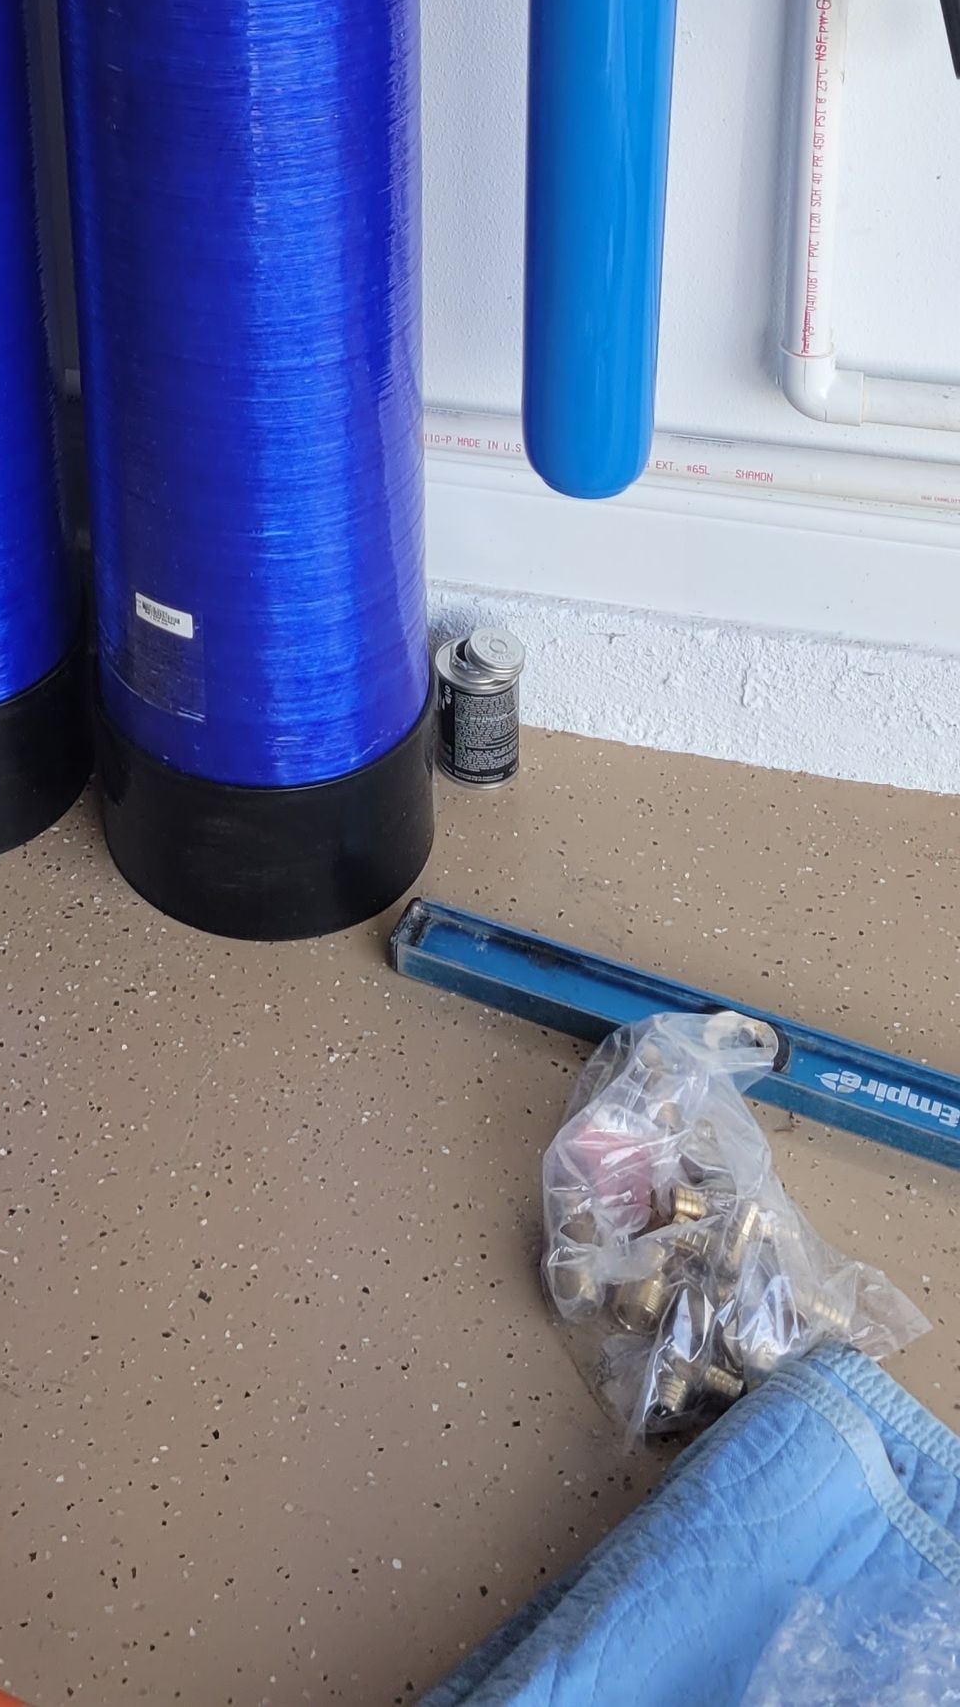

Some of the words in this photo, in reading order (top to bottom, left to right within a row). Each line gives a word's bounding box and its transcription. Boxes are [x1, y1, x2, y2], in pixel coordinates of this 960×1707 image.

[814, 110, 826, 127] PSI
[813, 133, 825, 150] 450
[812, 155, 824, 168] PR
[812, 173, 823, 185] 40
[810, 189, 822, 207] SCH
[809, 239, 820, 258] PVC
[457, 437, 481, 448] MADE
[487, 440, 498, 451] IN
[655, 460, 679, 472] EXT.
[837, 1069, 960, 1128] Empire
